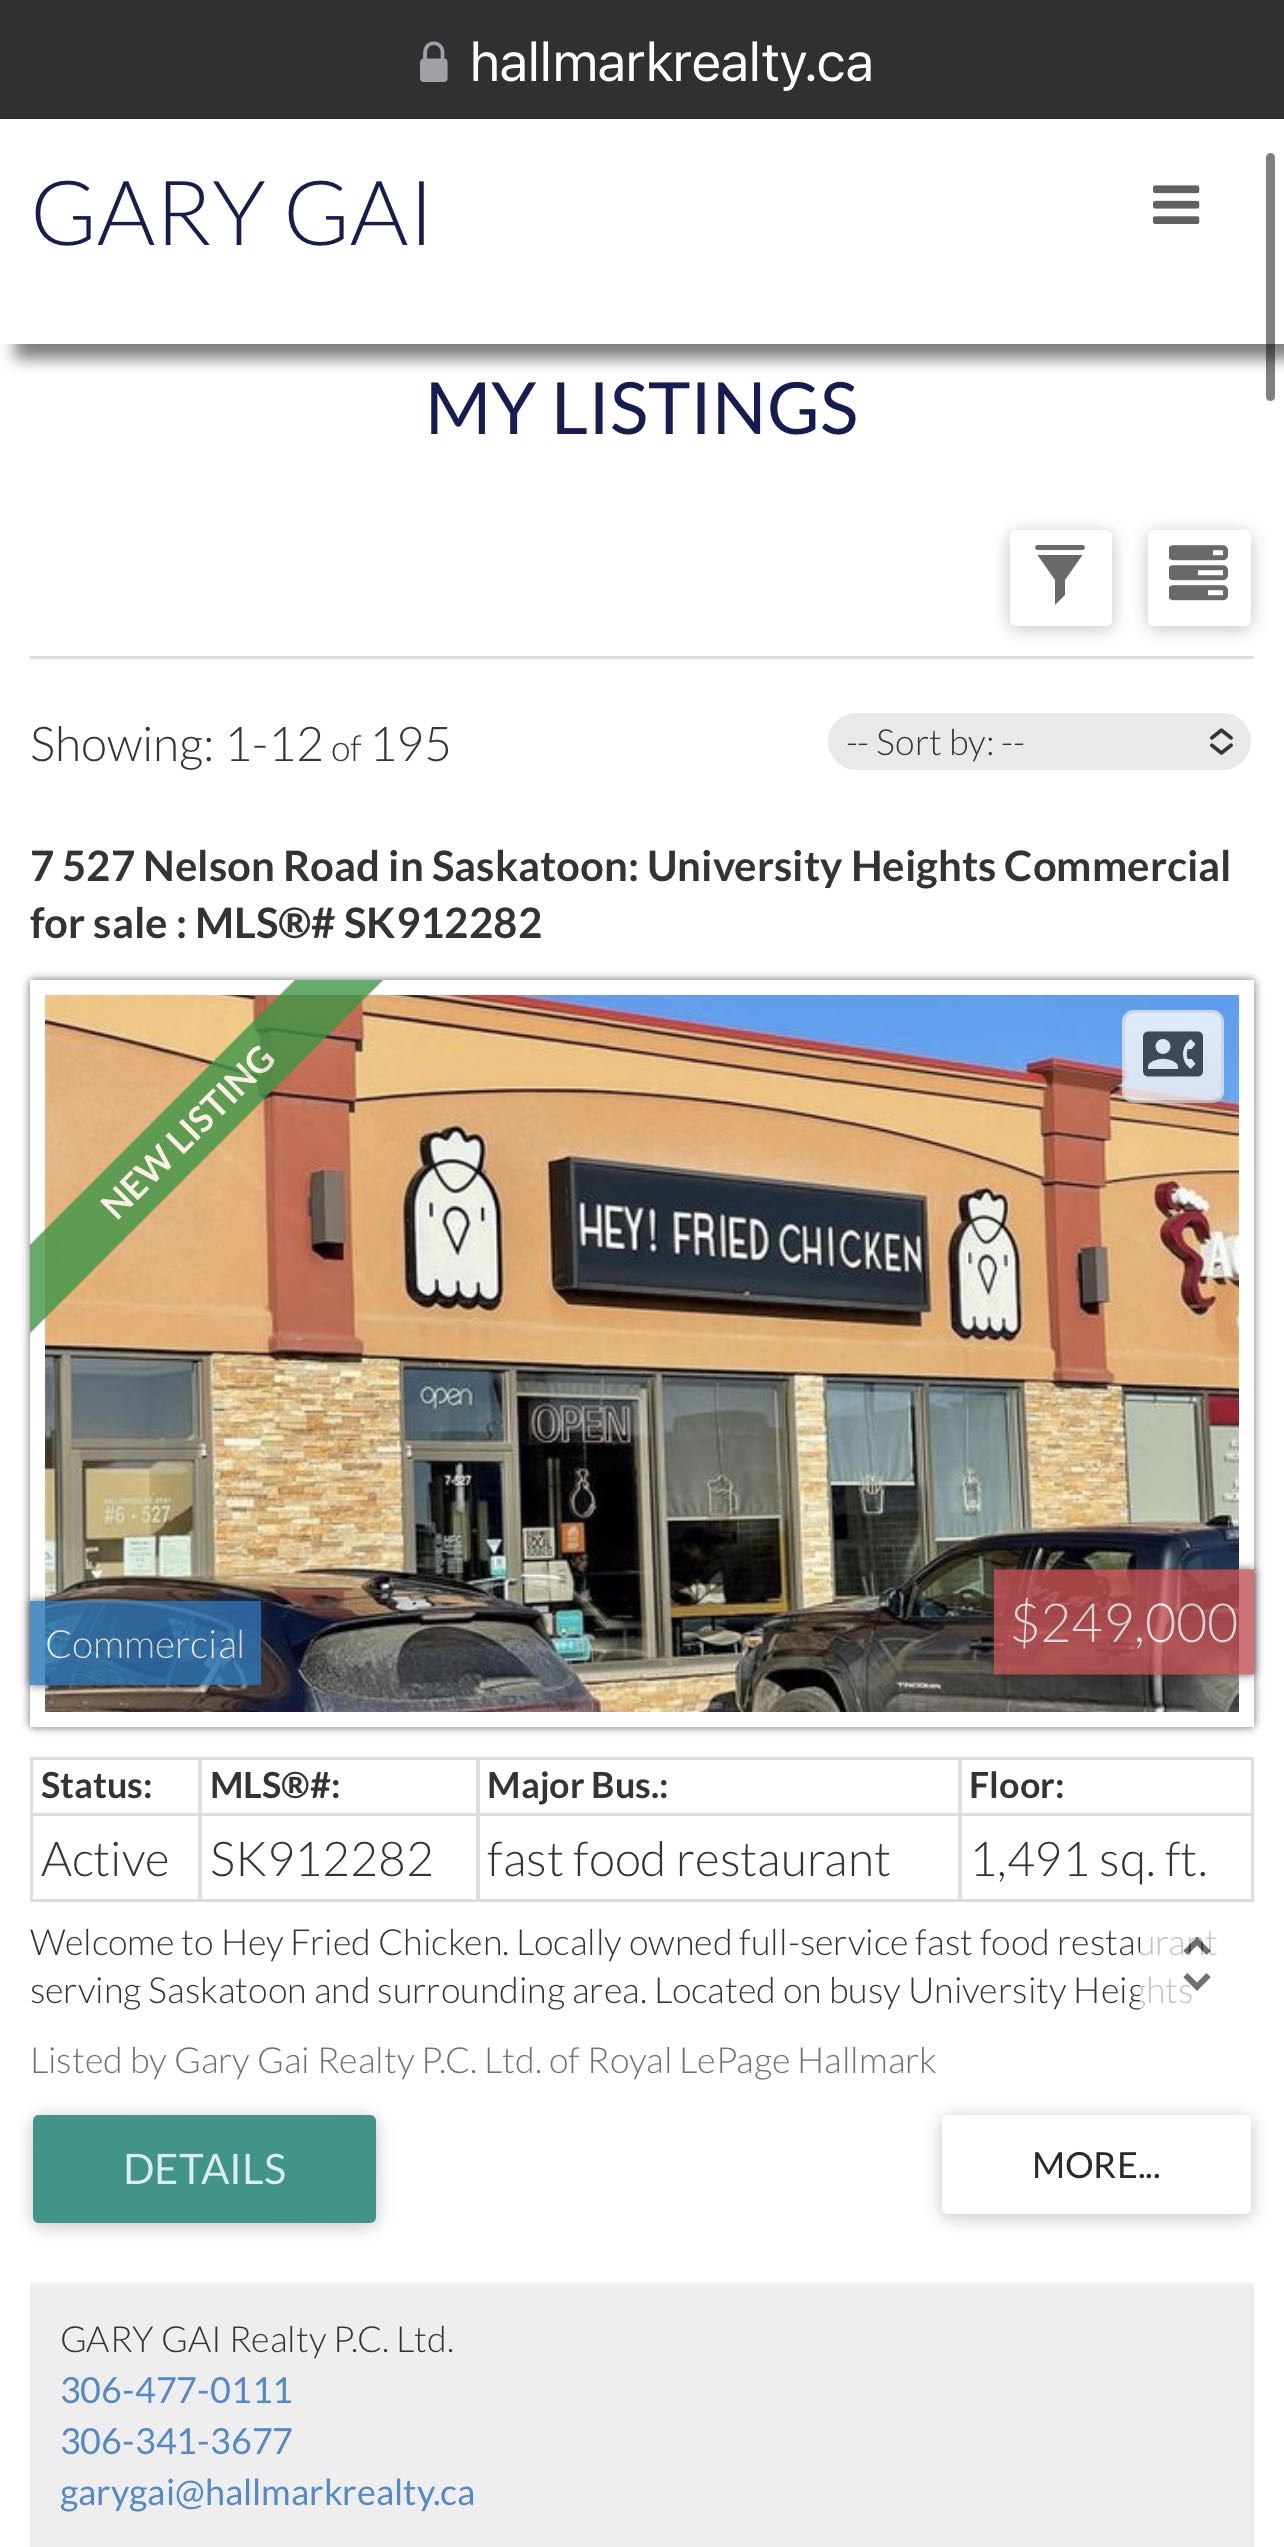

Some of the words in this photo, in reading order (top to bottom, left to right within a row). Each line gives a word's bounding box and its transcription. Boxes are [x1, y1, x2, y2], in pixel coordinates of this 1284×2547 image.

[473, 41, 871, 91] hallmarkrealty.ca
[35, 180, 265, 246] GARY
[288, 180, 424, 246] GAI
[431, 382, 536, 434] MY
[557, 382, 856, 435] LISTINGS
[32, 726, 211, 770] Showing:
[230, 726, 321, 761] 1-12
[332, 735, 361, 761] of
[375, 726, 448, 762] 195
[877, 729, 941, 756] Sort
[952, 729, 992, 762] by:
[32, 850, 53, 881] 7
[64, 850, 134, 882] 527
[146, 849, 273, 882] Nelson
[286, 849, 378, 882] Road
[390, 850, 422, 881] in
[433, 849, 637, 882] Saskatoon:
[649, 850, 842, 888] University
[854, 849, 995, 889] Heights
[1005, 849, 1229, 882] Commercial
[30, 907, 85, 939] for
[94, 906, 166, 939] sale
[198, 907, 335, 939] MLS®#
[345, 907, 541, 939] SK912282
[579, 1202, 657, 1252] HEY!
[673, 1211, 770, 1261] FRIED
[779, 1224, 923, 1273] CHICKEN
[420, 1386, 473, 1410] open
[532, 1404, 632, 1444] OPEN
[141, 1505, 172, 1524] 527
[42, 1772, 151, 1799] Status:
[212, 1771, 339, 1799] MLS®#:
[489, 1771, 584, 1805] Major
[593, 1772, 667, 1799] Bus.:
[971, 1771, 1063, 1798] Floor:
[41, 1841, 168, 1877] Active
[212, 1841, 431, 1877] SK912282
[488, 1841, 563, 1877] fast
[573, 1841, 662, 1877] food
[680, 1843, 890, 1877] restaurant
[975, 1841, 1087, 1882] 1,491
[1101, 1851, 1153, 1885] sq.
[1165, 1841, 1205, 1877] ft.
[30, 1929, 173, 1956] Welcome
[182, 1930, 212, 1956] to
[224, 1929, 283, 1962] Hey
[293, 1928, 368, 1955] Fried
[380, 1928, 507, 1956] Chicken.
[519, 1928, 621, 1962] Locally
[630, 1929, 730, 1956] owned
[739, 1928, 907, 1956] full-service
[915, 1929, 972, 1956] fast
[980, 1928, 1047, 1956] food
[1060, 1931, 1216, 1956] restaurant
[32, 1977, 141, 2010] serving
[149, 1976, 304, 2004] Saskatoon
[316, 1976, 368, 2004] and
[379, 1976, 565, 2010] surrounding
[574, 1985, 645, 2004] area.
[657, 1976, 773, 2004] Located
[784, 1985, 819, 2004] on
[832, 1976, 900, 2010] busy
[911, 1977, 1066, 2010] University
[1076, 1976, 1193, 2010] Heights
[33, 2046, 120, 2073] Listed
[133, 2046, 166, 2080] by
[176, 2047, 249, 2080] Gary
[259, 2047, 307, 2073] Gai
[321, 2046, 414, 2080] Realty
[425, 2047, 475, 2073] P.C.
[488, 2046, 540, 2073] Ltd.
[550, 2047, 579, 2073] of
[591, 2047, 669, 2080] Royal
[682, 2047, 789, 2080] LePage
[801, 2046, 936, 2073] Hallmark
[126, 2153, 285, 2184] DETAILS
[1035, 2152, 1159, 2179] MORE...
[62, 2326, 153, 2353] GARY
[163, 2326, 218, 2353] GAI
[233, 2325, 326, 2359] Realty
[337, 2326, 387, 2353] P.C.
[399, 2325, 452, 2352] Ltd.
[62, 2377, 291, 2404] 306-477-0111
[62, 2428, 292, 2455] 306-341-3677
[61, 2478, 473, 2512] garygai@hallmarkrealty.ca
